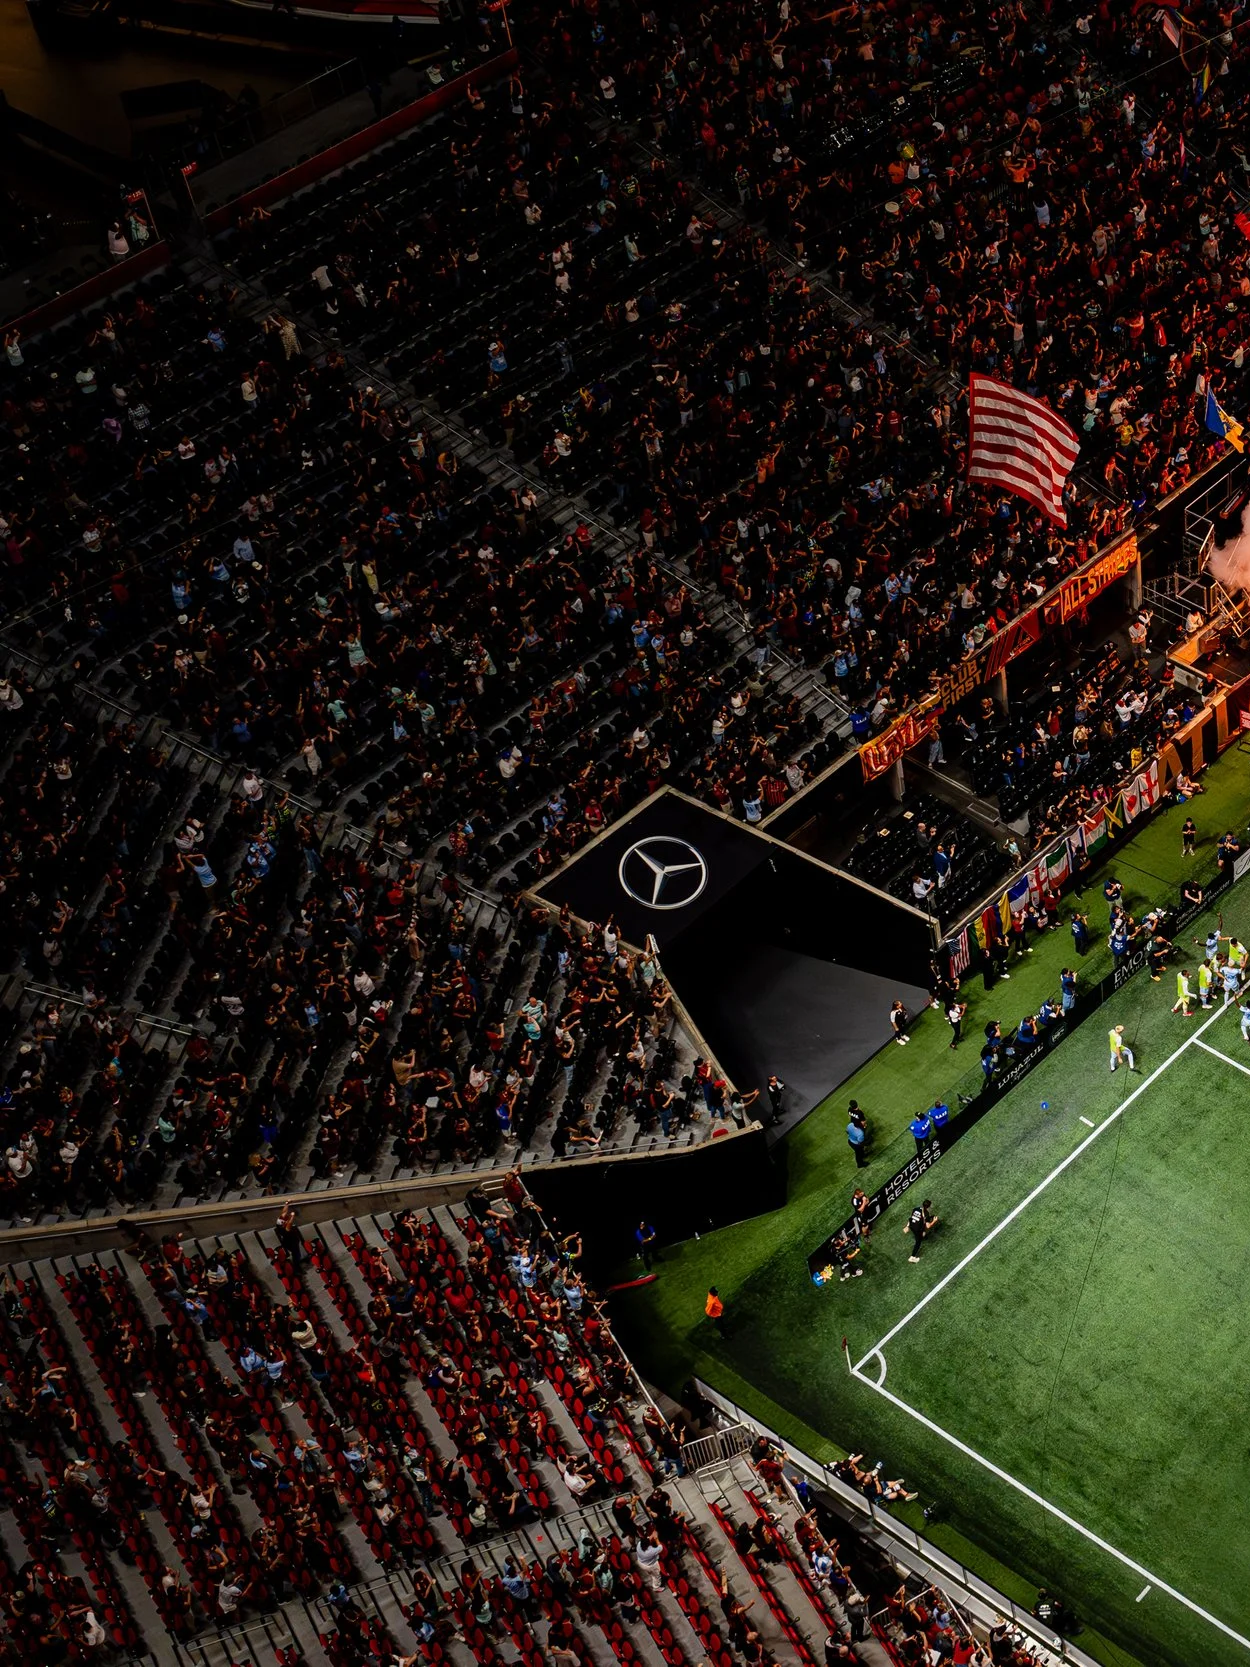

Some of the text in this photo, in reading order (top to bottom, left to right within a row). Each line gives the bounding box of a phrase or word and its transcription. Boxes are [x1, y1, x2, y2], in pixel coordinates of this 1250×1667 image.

[1064, 579, 1086, 616] ALL
[940, 660, 978, 697] CLUB
[943, 669, 982, 711] FIRST
[1114, 952, 1143, 984] EMO
[998, 1045, 1043, 1089] LUNAZUL
[885, 1140, 940, 1195] HOTELS &
[887, 1149, 941, 1205] RESORTS
